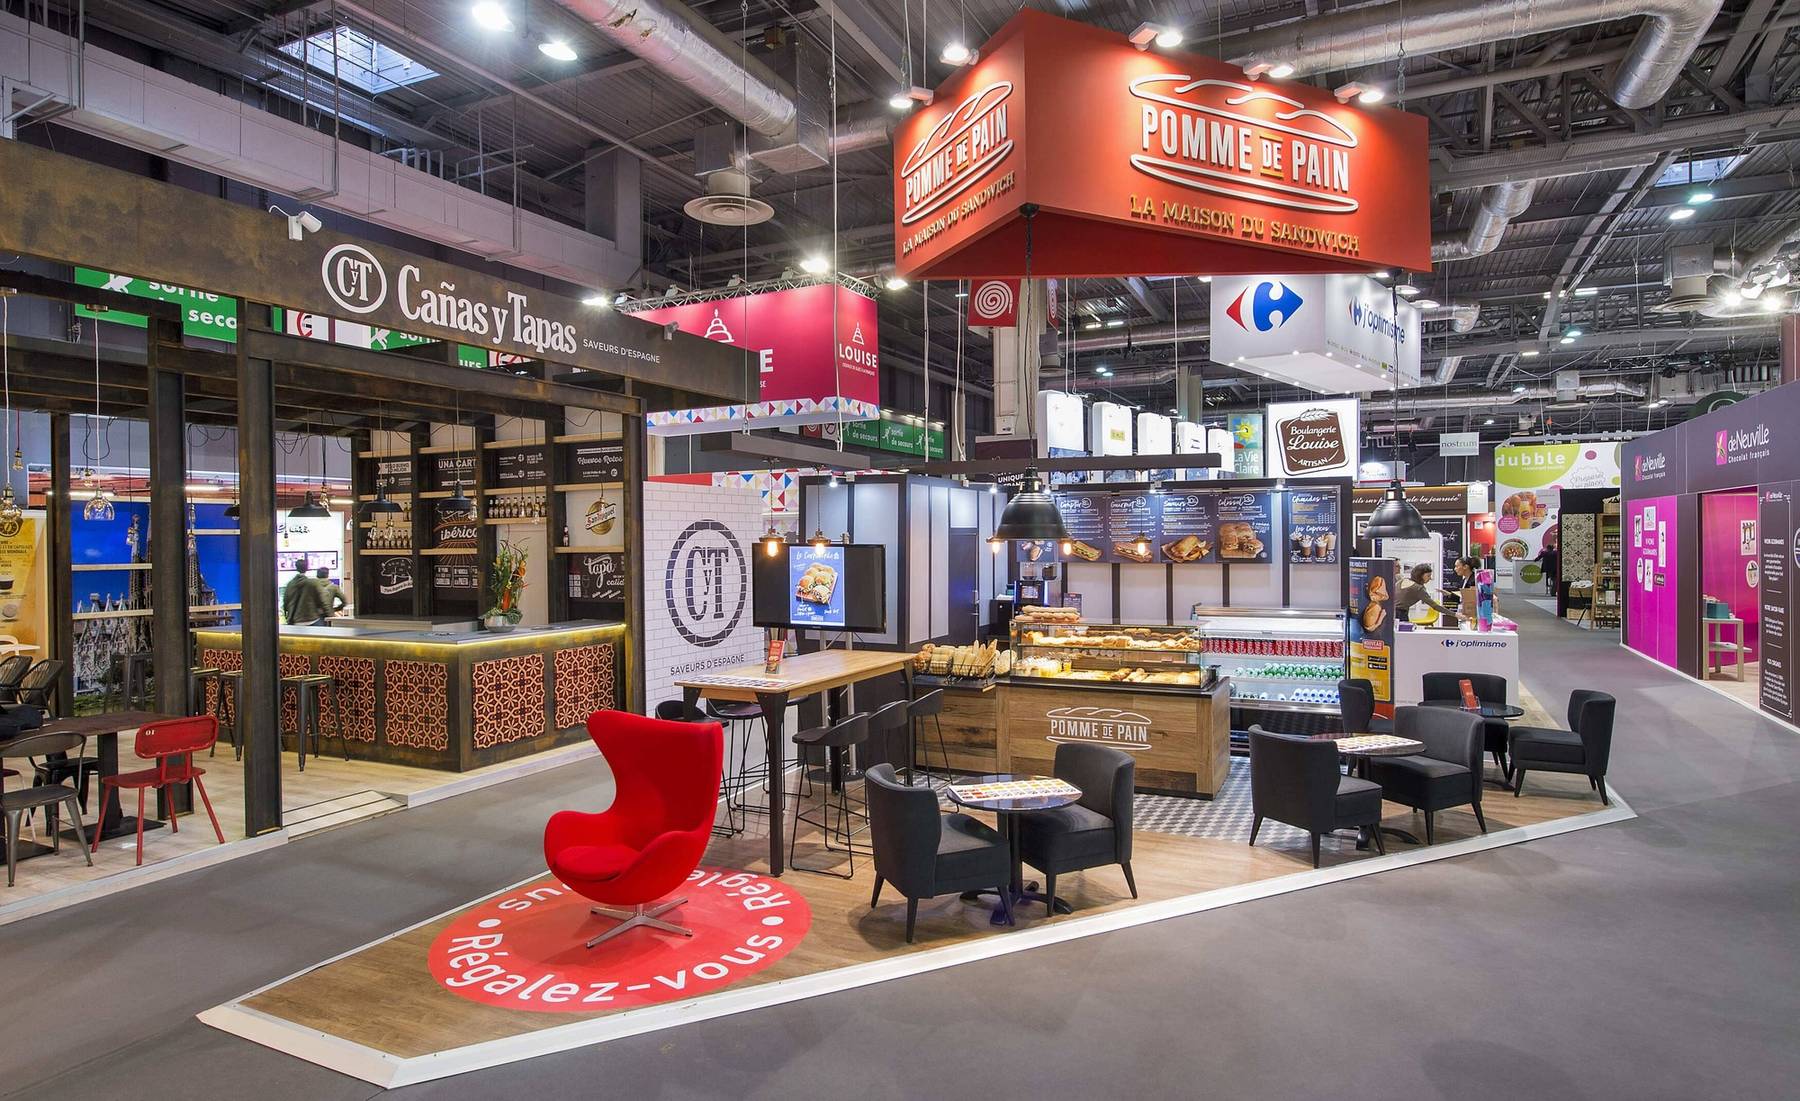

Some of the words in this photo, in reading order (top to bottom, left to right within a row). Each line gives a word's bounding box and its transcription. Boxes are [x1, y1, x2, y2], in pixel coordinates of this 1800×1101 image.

[904, 143, 953, 201] POMME
[972, 103, 1008, 161] PAIN
[1141, 104, 1253, 172] POMME
[1262, 138, 1282, 169] DE
[1291, 141, 1350, 192] PAIN
[902, 240, 914, 254] LA
[914, 221, 945, 248] MAISON
[946, 208, 959, 226] DU
[960, 173, 1015, 220] SANDWICH
[1130, 195, 1157, 219] LA
[1162, 199, 1235, 232] MAISON
[1240, 215, 1264, 237] DU
[1270, 220, 1361, 254] SANDWICH
[398, 264, 489, 335] Cañas
[492, 305, 509, 344] y
[507, 291, 577, 354] Tapas
[583, 339, 619, 354] SAVEURS
[620, 347, 660, 364] D'ESPAGNE
[839, 343, 878, 368] LOUISE
[1290, 425, 1337, 436] Boulangerie
[1287, 434, 1339, 451] Louise
[1441, 439, 1477, 448] nostrum
[438, 460, 454, 469] UNA
[603, 454, 623, 464] Rotos
[1235, 451, 1245, 462] La
[1245, 451, 1259, 462] Vie
[1297, 456, 1329, 467] ARTISAN
[1496, 452, 1565, 467] dubble
[1728, 452, 1748, 463] Chocolat
[1749, 449, 1770, 459] français
[1235, 463, 1259, 474] Claire
[584, 554, 617, 588] tapa
[1456, 639, 1507, 648] j'optimisme
[670, 660, 705, 676] SAVEURS
[706, 653, 745, 669] D'ESPAGNE
[1050, 719, 1100, 738] POMME
[1117, 724, 1148, 742] PAIN
[445, 933, 784, 1004] Régalez-vous
